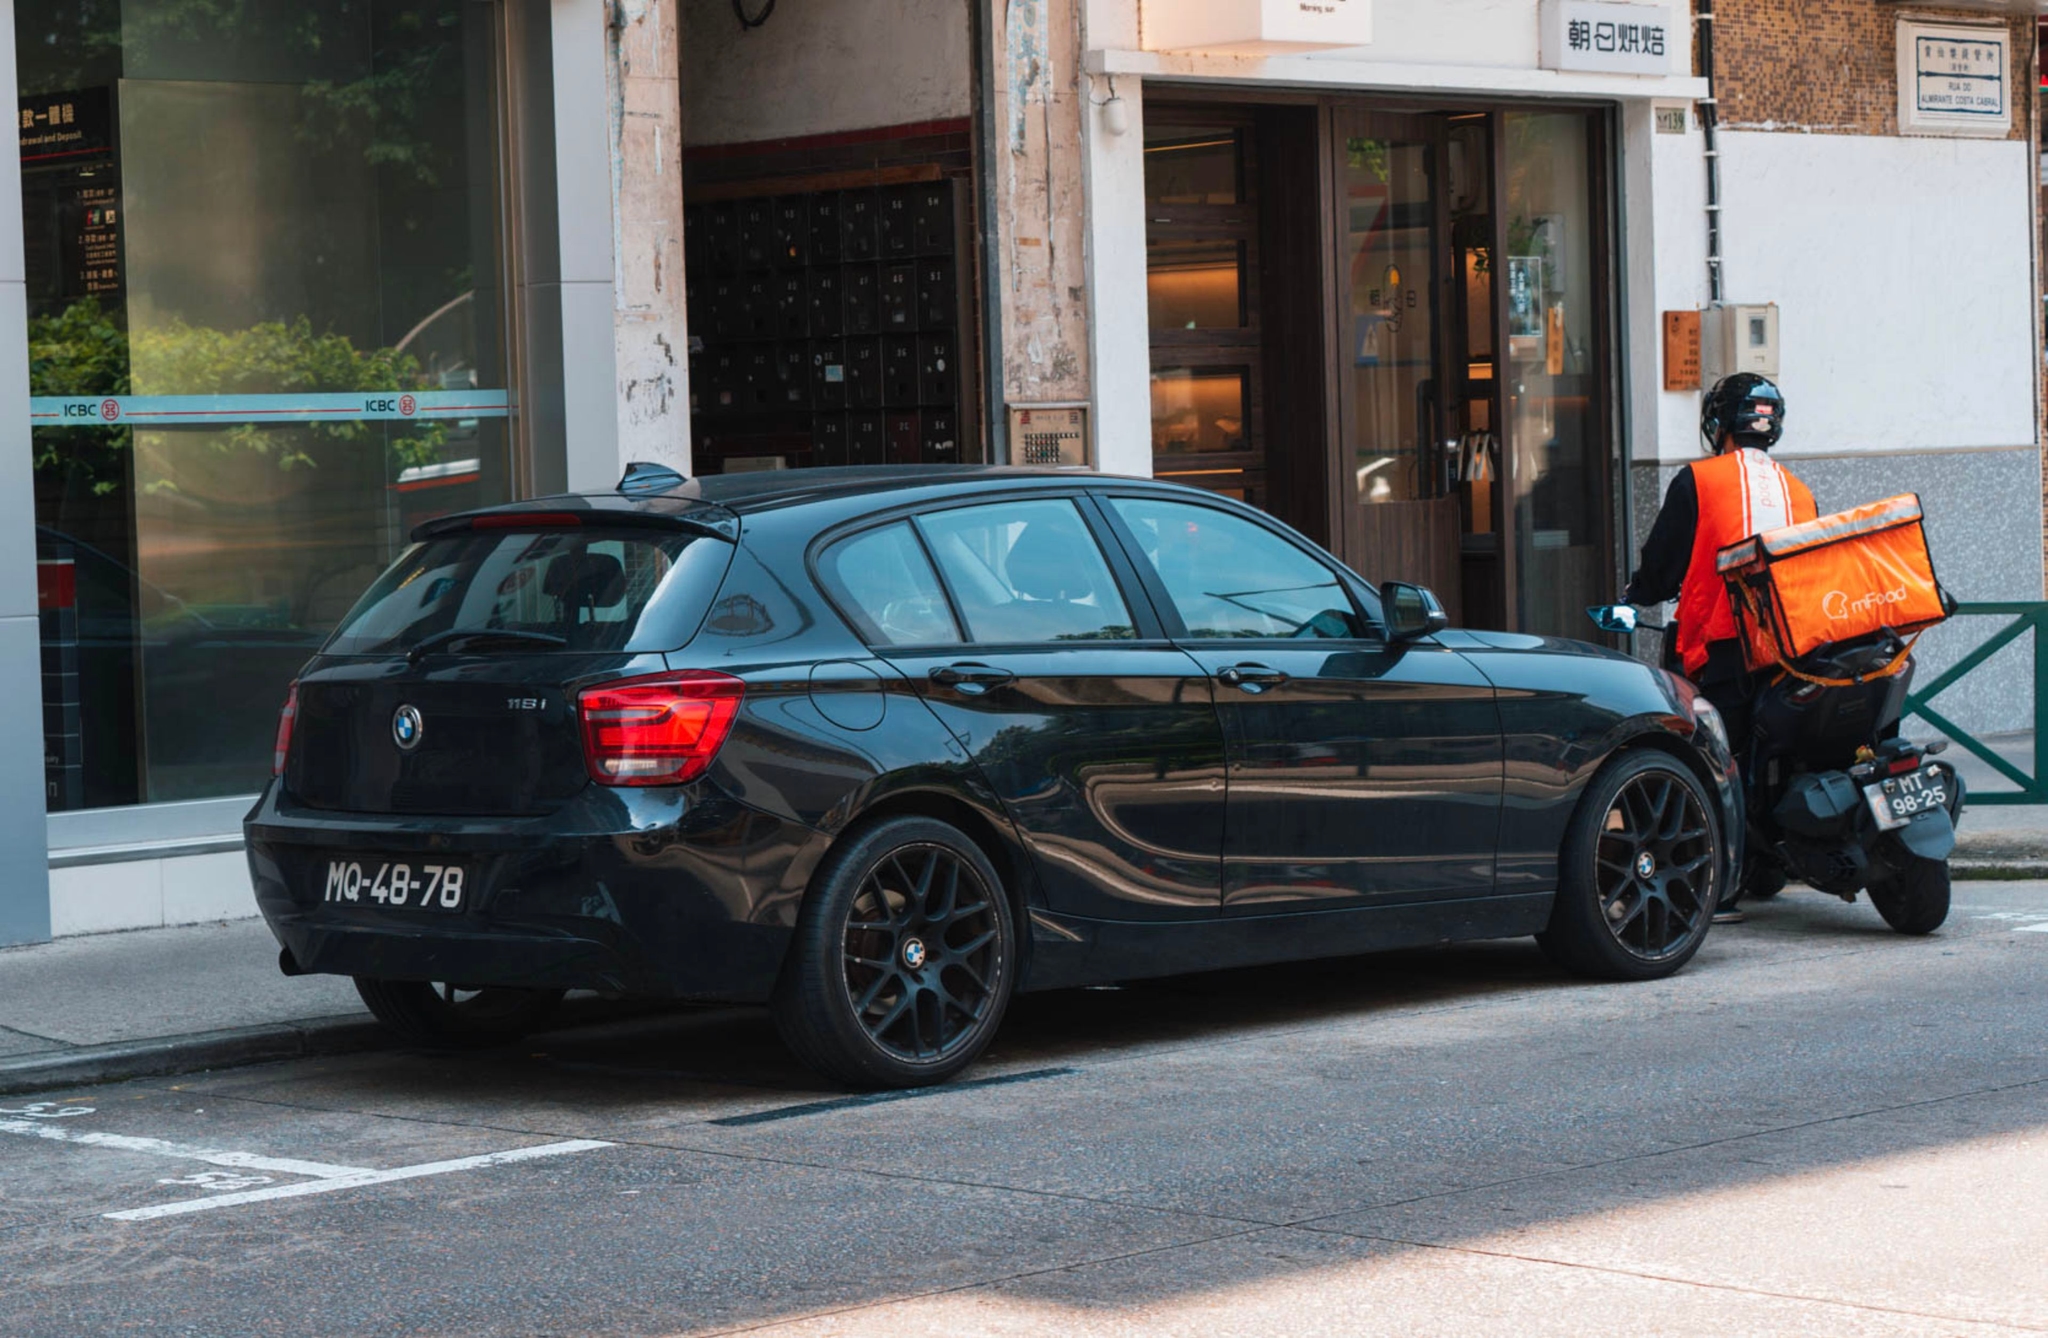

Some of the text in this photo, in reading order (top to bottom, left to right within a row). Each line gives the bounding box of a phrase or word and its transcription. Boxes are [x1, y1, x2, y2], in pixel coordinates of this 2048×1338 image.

[1568, 19, 1664, 56] 朝日烘焙
[1948, 81, 1972, 92] RUA DO
[1921, 94, 1999, 107] ALMIRANTE COSTA CABRAL
[44, 132, 56, 144] and
[57, 130, 82, 142] Deposit
[64, 403, 97, 417] ICBC
[365, 399, 396, 412] ICBC
[1851, 583, 1907, 614] mFood
[1898, 772, 1923, 795] MT
[1892, 785, 1947, 815] 98-25
[324, 861, 464, 908] MQ-48-78
